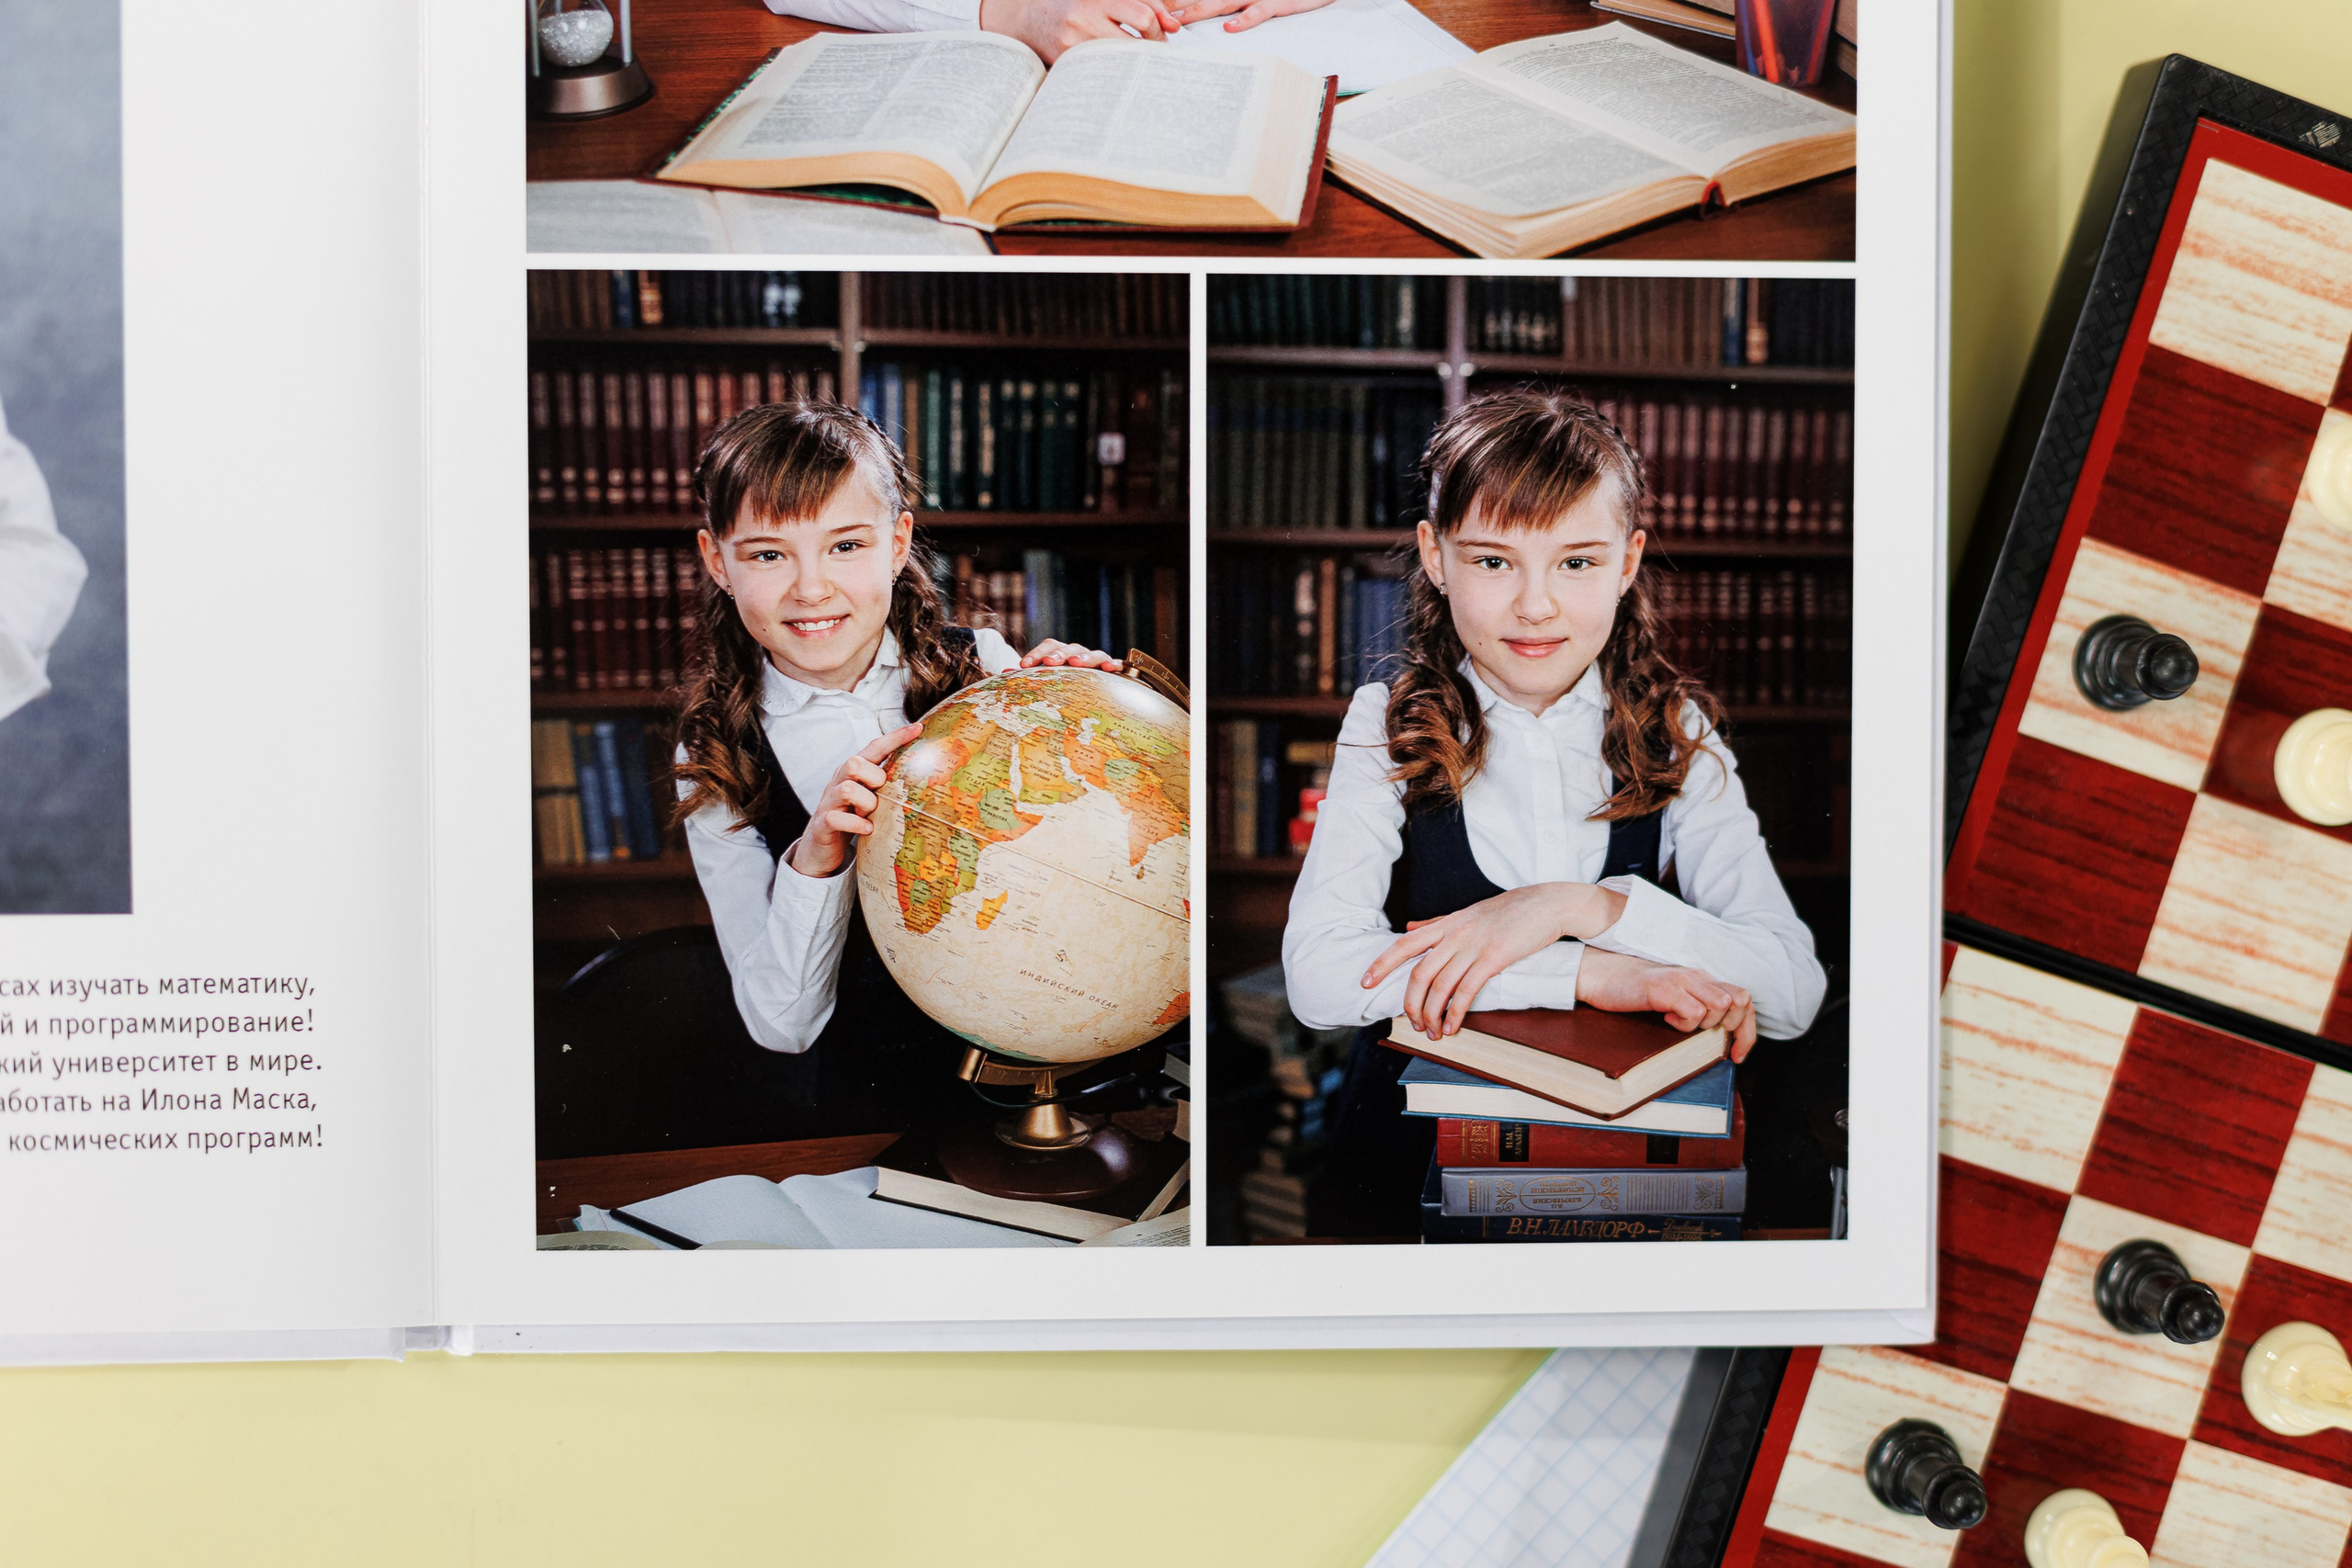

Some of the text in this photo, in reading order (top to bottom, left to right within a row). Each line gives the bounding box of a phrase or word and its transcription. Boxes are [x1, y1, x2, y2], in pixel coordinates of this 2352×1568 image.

[51, 978, 149, 1002] изучать
[159, 976, 315, 1000] математику,
[1020, 968, 1119, 1010] ИНДИЙСКИЙ ОКЕАН
[26, 1019, 39, 1035] и
[50, 1009, 313, 1040] программирование!
[52, 1055, 217, 1080] университет
[227, 1055, 239, 1072] в
[250, 1054, 322, 1077] мире.
[102, 1094, 130, 1111] на
[141, 1088, 222, 1111] Илона
[232, 1087, 317, 1112] Маска,
[9, 1124, 322, 1154] космических программ!
[1507, 1217, 1543, 1235] В.Н.
[1544, 1218, 1645, 1238] ЛАМЗДОРФ
